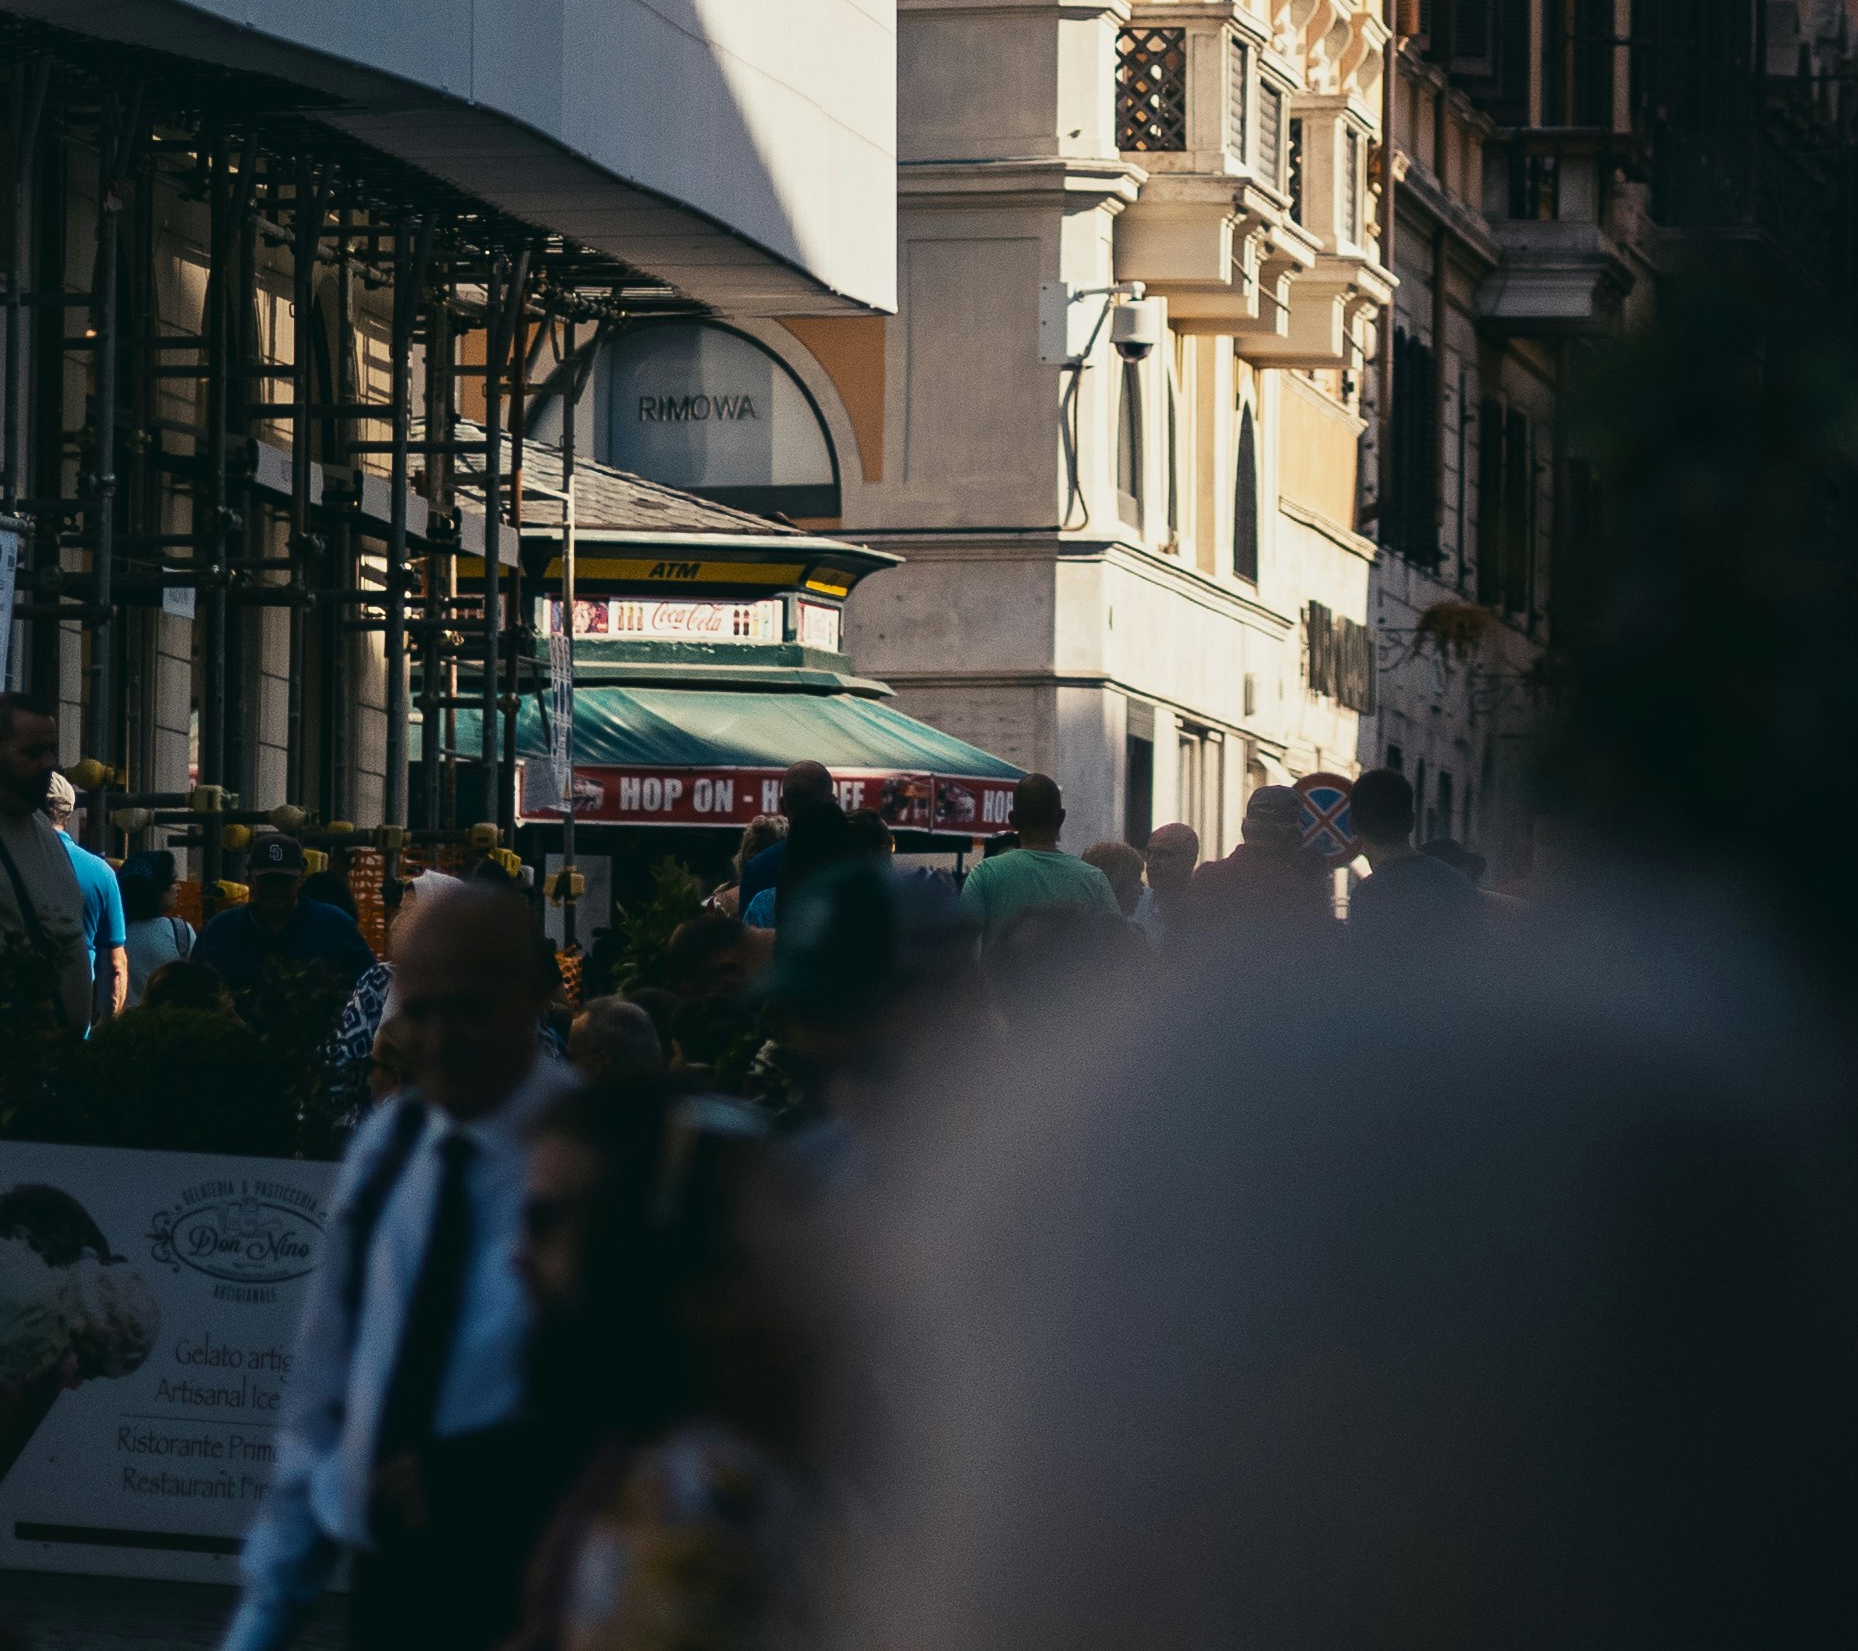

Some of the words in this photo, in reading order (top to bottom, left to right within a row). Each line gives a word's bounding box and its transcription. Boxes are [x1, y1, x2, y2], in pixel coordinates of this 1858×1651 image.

[638, 394, 758, 423] RIMOWA
[648, 562, 701, 578] ATM
[620, 777, 683, 811] HOP
[693, 779, 734, 812] ON
[832, 781, 866, 812] FF
[188, 1225, 242, 1257] Don
[246, 1231, 311, 1262] Nino
[175, 1332, 243, 1368] Gelato
[153, 1375, 248, 1408] Artisanal
[251, 1384, 282, 1411] Ice
[116, 1425, 224, 1459] Ristorante
[122, 1466, 236, 1500] Restaurant
[240, 1475, 271, 1501] Fir
